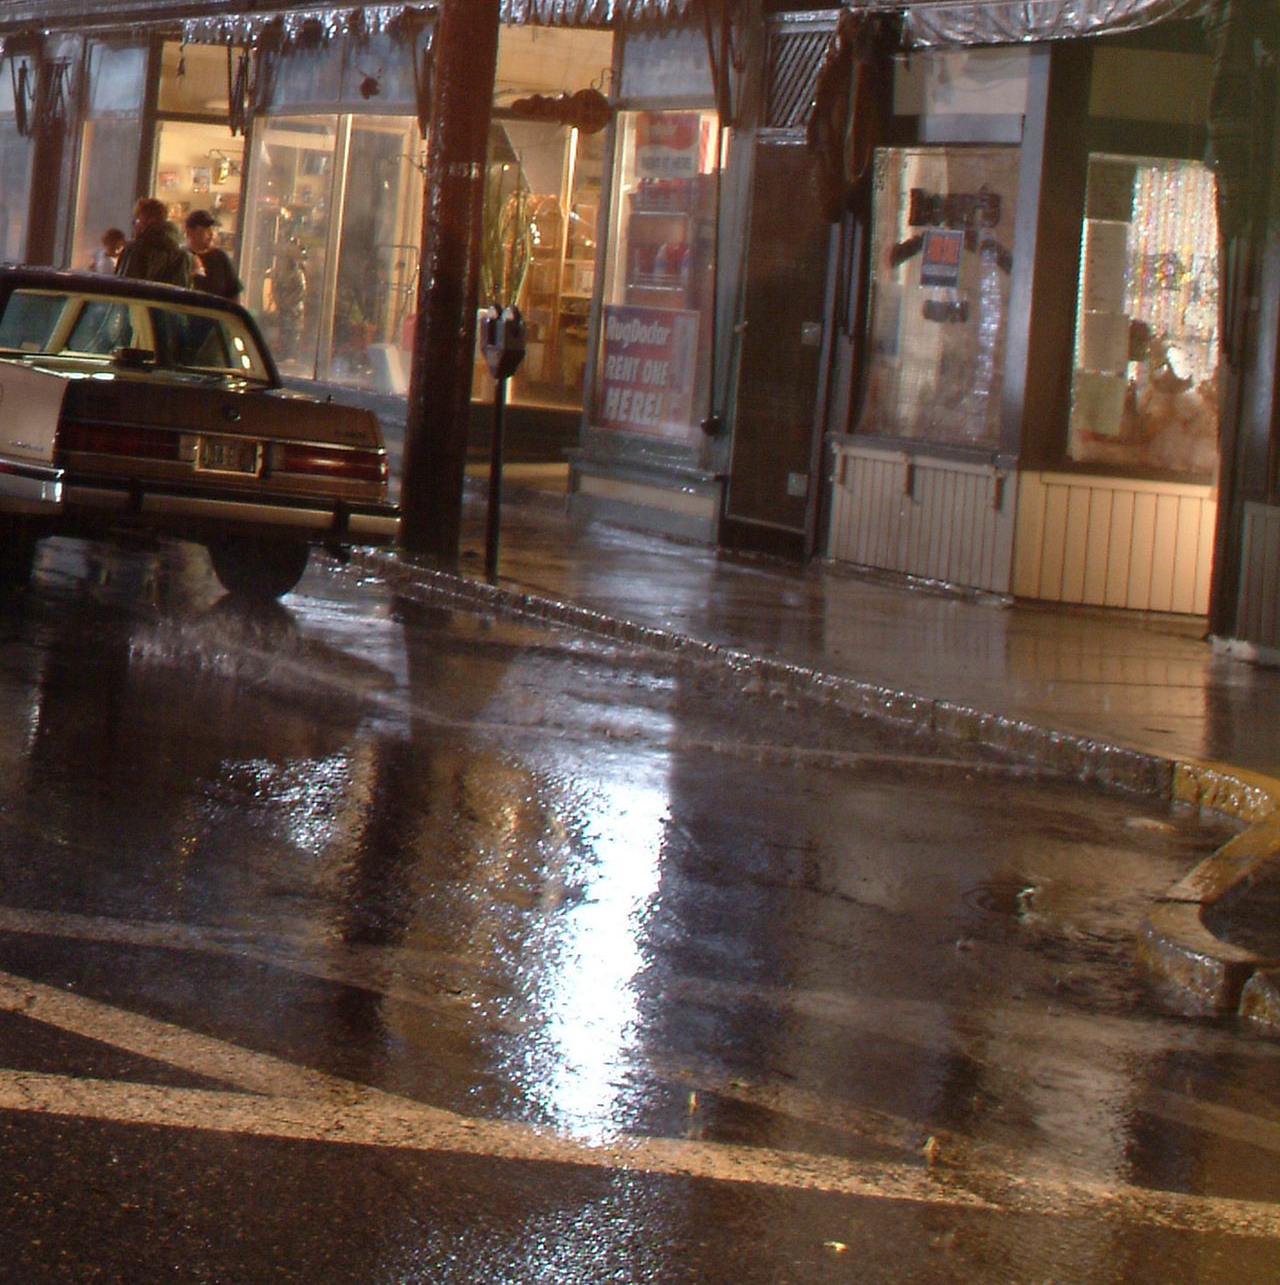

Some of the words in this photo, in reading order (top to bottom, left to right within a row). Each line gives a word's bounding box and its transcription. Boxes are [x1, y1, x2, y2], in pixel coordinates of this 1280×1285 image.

[605, 355, 640, 383] RENT
[642, 359, 670, 388] ONE
[603, 386, 663, 426] HERE!
